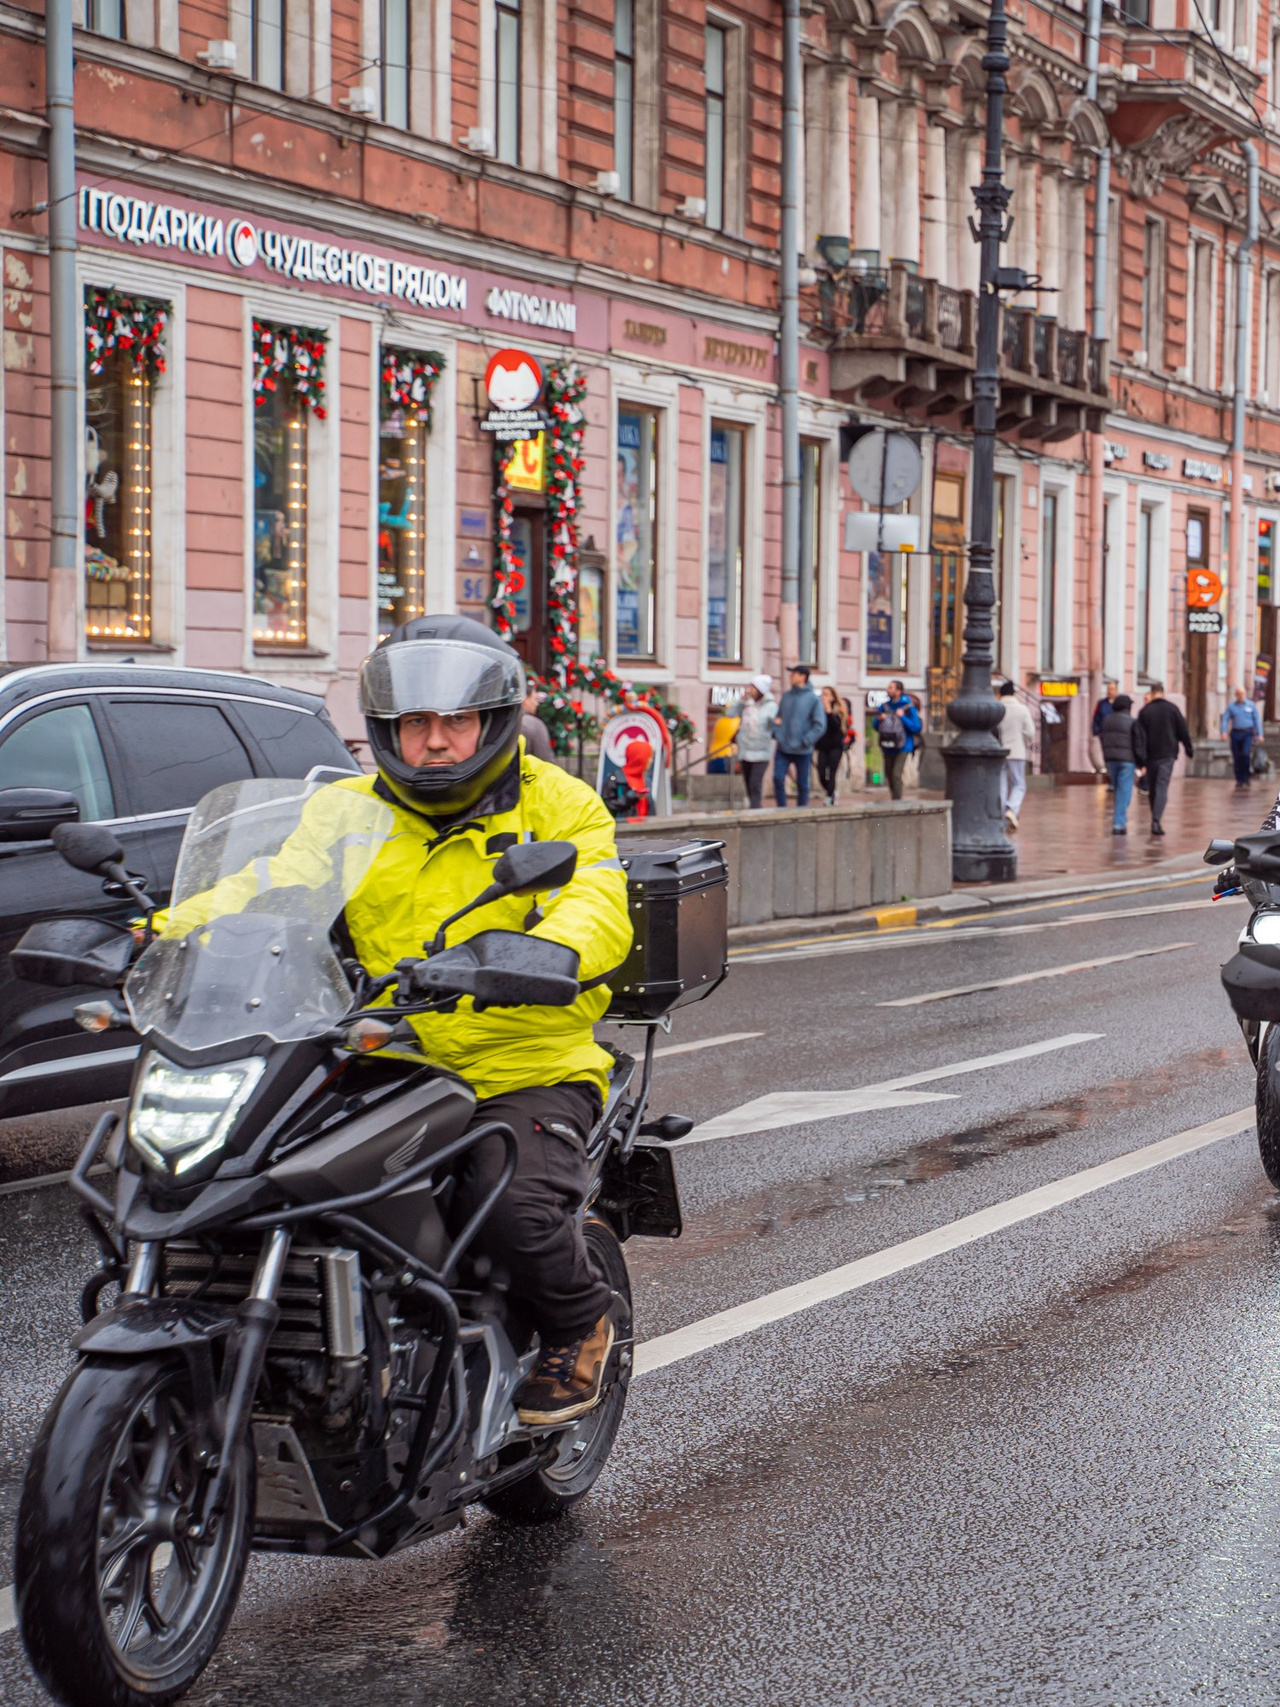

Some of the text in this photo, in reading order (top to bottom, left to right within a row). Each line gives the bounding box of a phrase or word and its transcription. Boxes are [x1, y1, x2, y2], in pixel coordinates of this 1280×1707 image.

[79, 185, 224, 258] ПОДАРКИ
[257, 229, 468, 312] ЧУДЕСНОЕ РЯДОМ
[486, 287, 577, 333] ФОТОСАЛОН
[1188, 612, 1221, 623] DODO
[1188, 622, 1221, 633] PIZZA
